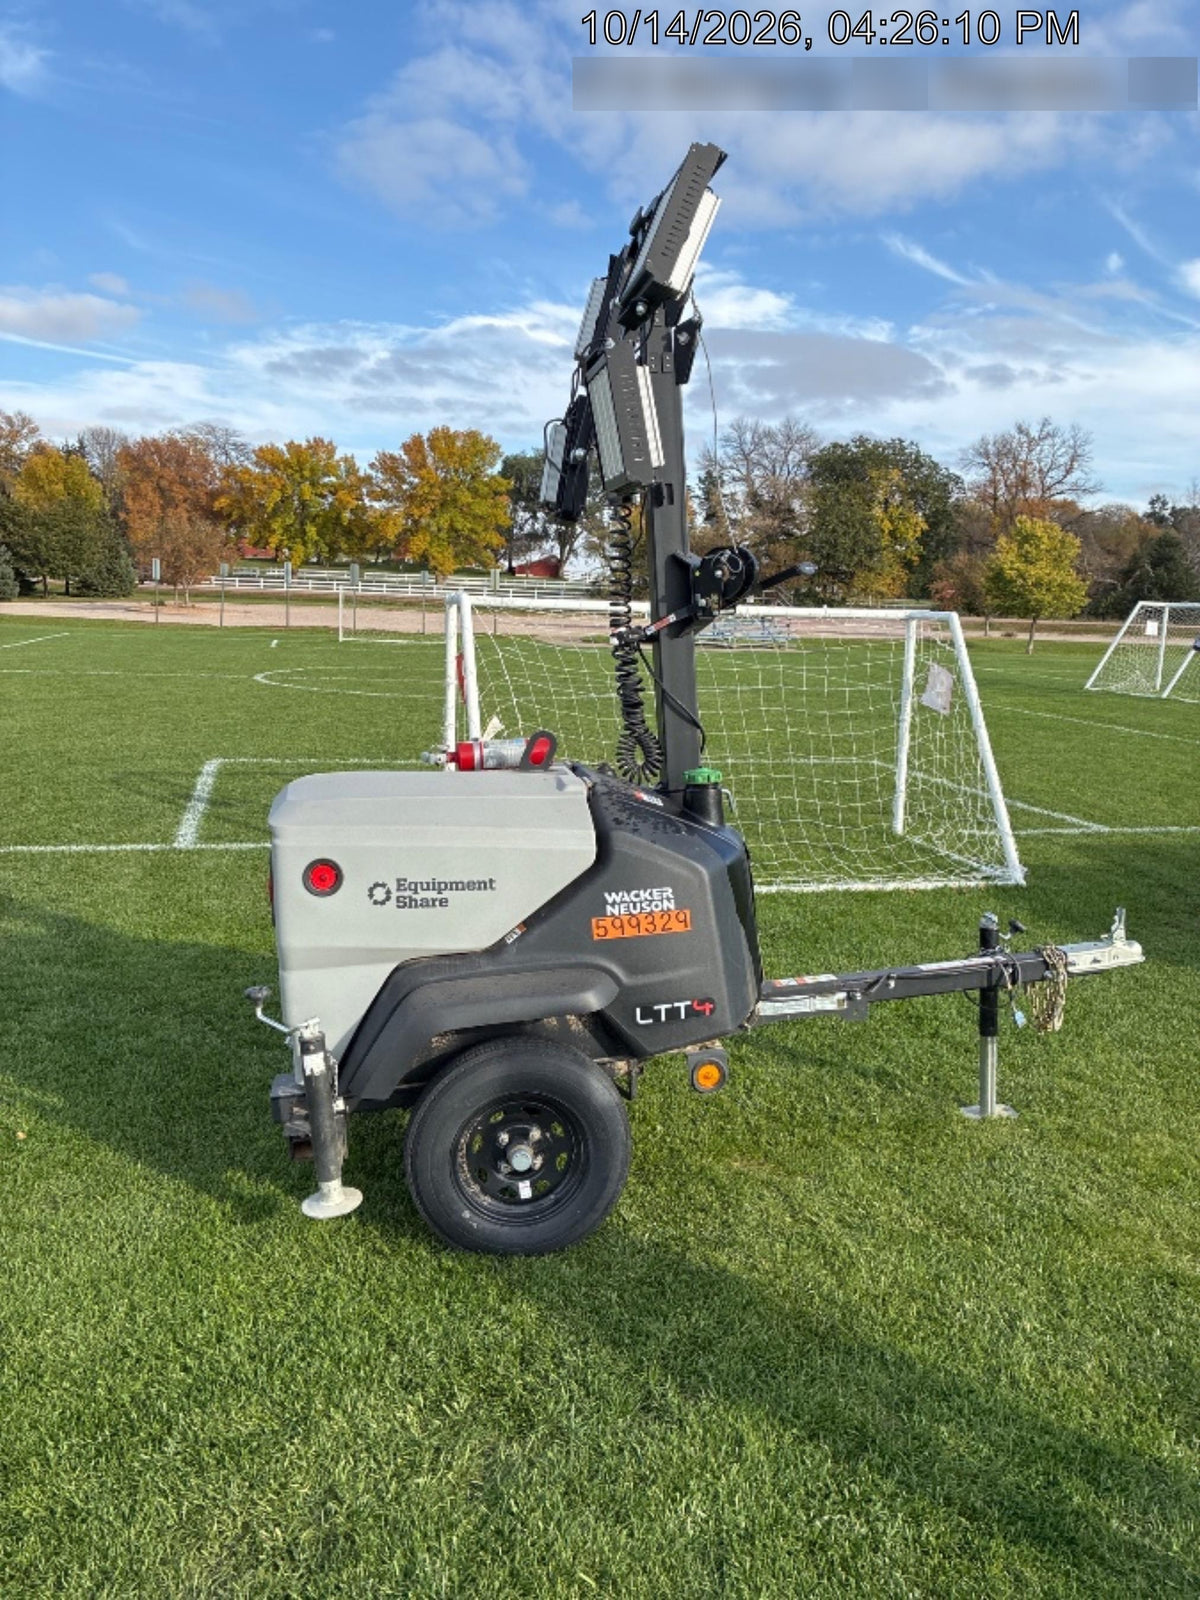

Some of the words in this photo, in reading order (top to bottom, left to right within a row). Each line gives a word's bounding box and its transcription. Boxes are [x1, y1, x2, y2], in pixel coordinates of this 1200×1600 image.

[395, 878, 496, 895] Equipment
[603, 886, 675, 904] WACKER
[395, 895, 449, 909] Share
[605, 899, 675, 916] NEUSON
[594, 911, 689, 938] 599329
[635, 999, 714, 1025] LTT4
